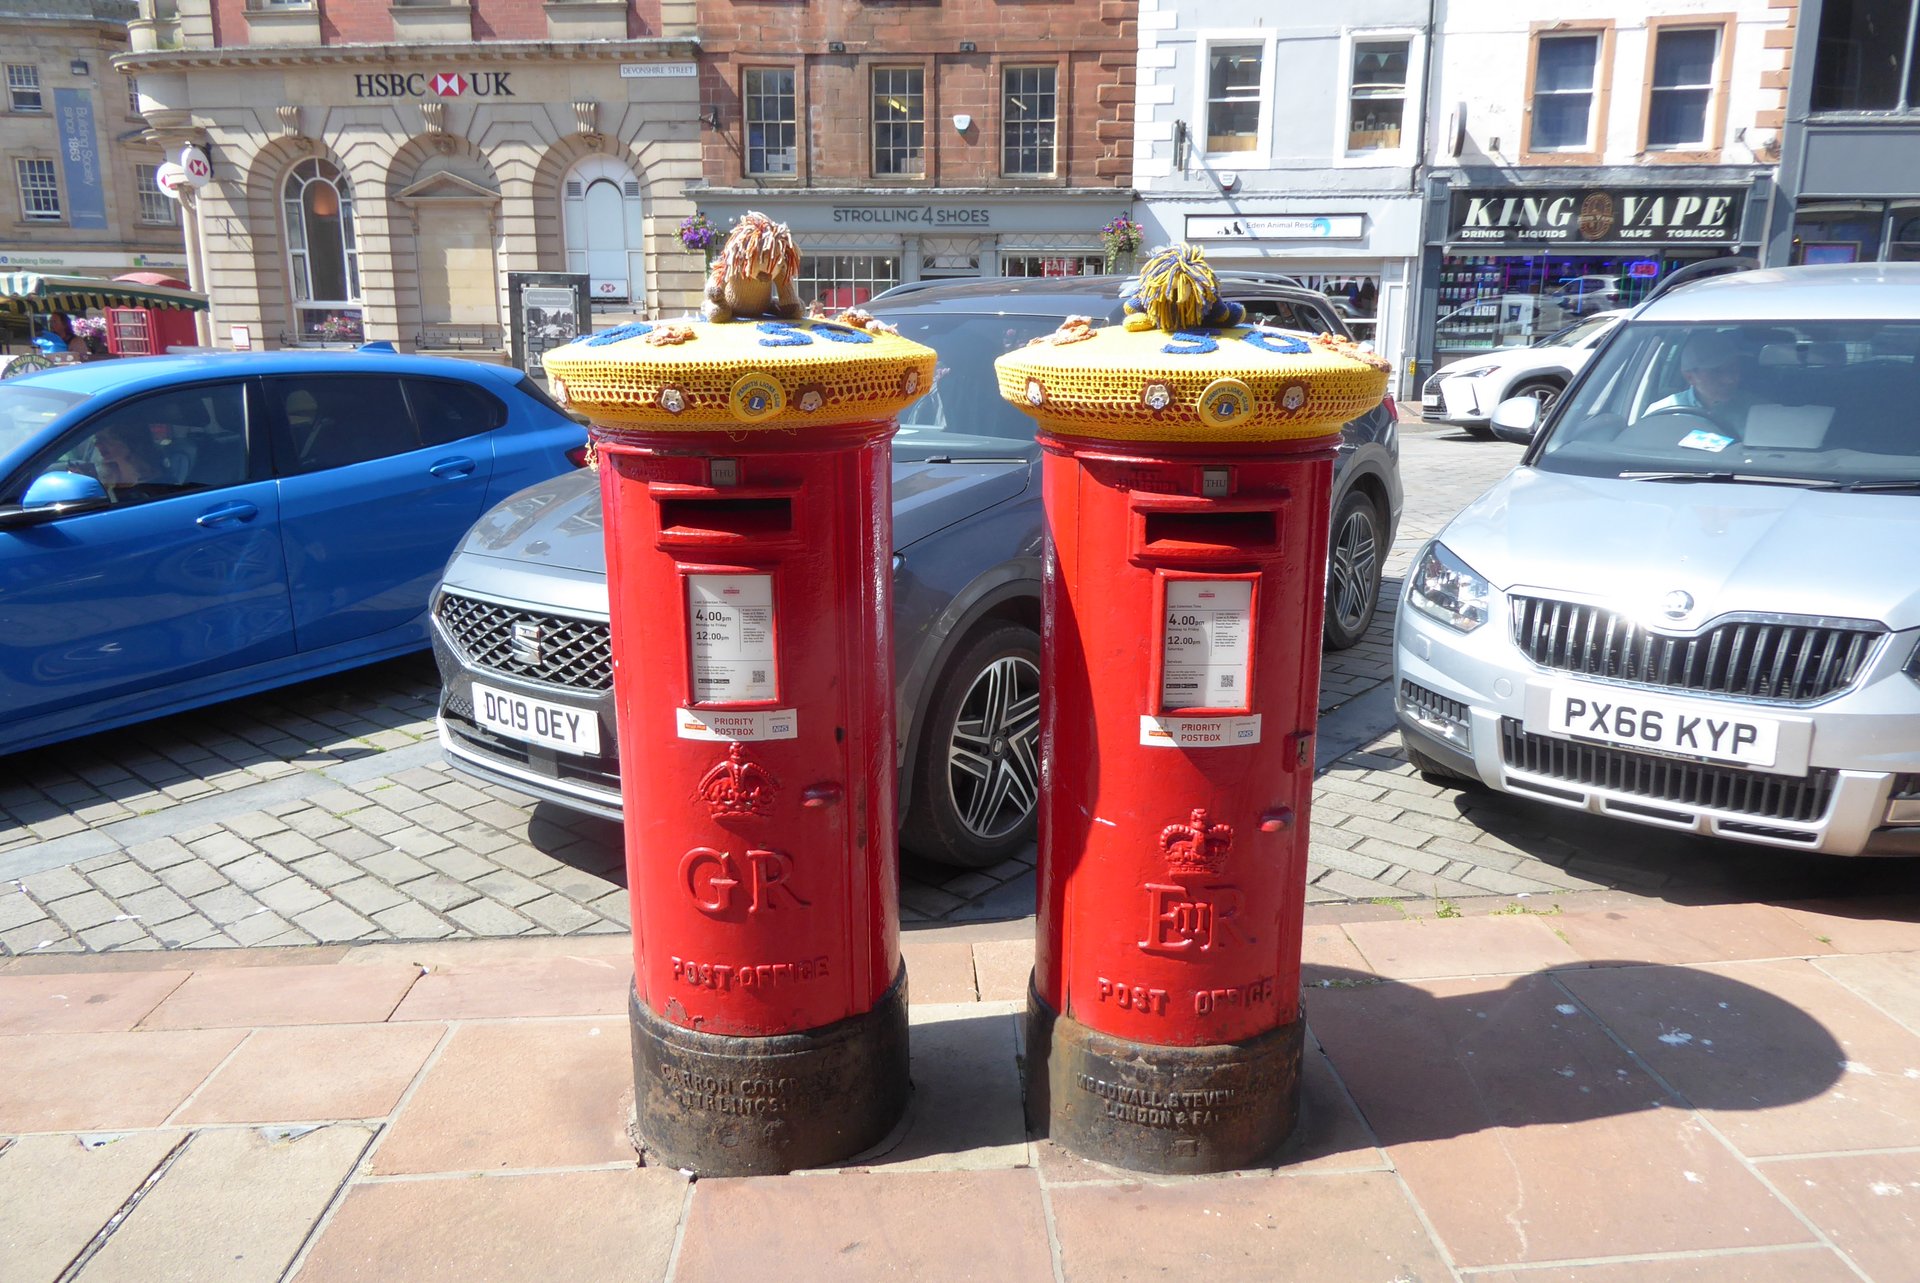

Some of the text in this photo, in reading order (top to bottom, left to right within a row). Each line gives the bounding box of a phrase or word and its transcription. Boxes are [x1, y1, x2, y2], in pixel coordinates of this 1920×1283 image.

[622, 66, 694, 75] DEVONSHIRE STREET
[354, 72, 515, 97] HSBC UK
[64, 106, 75, 134] since
[76, 107, 94, 186] Building Society
[833, 206, 989, 225] STROLLING 4 SHOES
[1462, 196, 1575, 227] KING
[1621, 196, 1732, 227] VAPE
[1461, 230, 1726, 239] DRINKS LIQUIDS VAPE TOBACCO
[10, 257, 38, 265] Building
[39, 257, 64, 265] Society
[1045, 260, 1074, 271] SALE
[752, 397, 761, 409] L
[1220, 403, 1229, 415] L
[713, 469, 734, 477] THU
[1204, 479, 1226, 488] THU
[696, 609, 732, 622] 4.00pm
[1168, 613, 1205, 626] 4.00pm
[696, 631, 730, 641] 12.00pm
[1167, 636, 1201, 645] 12.00pm
[484, 691, 580, 743] DC19 OEY
[714, 717, 754, 726] PRIORITY
[714, 727, 754, 736] POSTBOX
[1181, 723, 1222, 731] PRIORITY
[1565, 696, 1758, 755] PX66 KYP
[1181, 734, 1221, 742] POSTBOX
[1238, 730, 1253, 738] NHS
[678, 846, 812, 914] GR
[671, 955, 830, 991] POST OFFICE
[1098, 976, 1274, 1014] POST OFFICE
[660, 1062, 733, 1095] CARRON
[1105, 1099, 1172, 1128] LONDON
